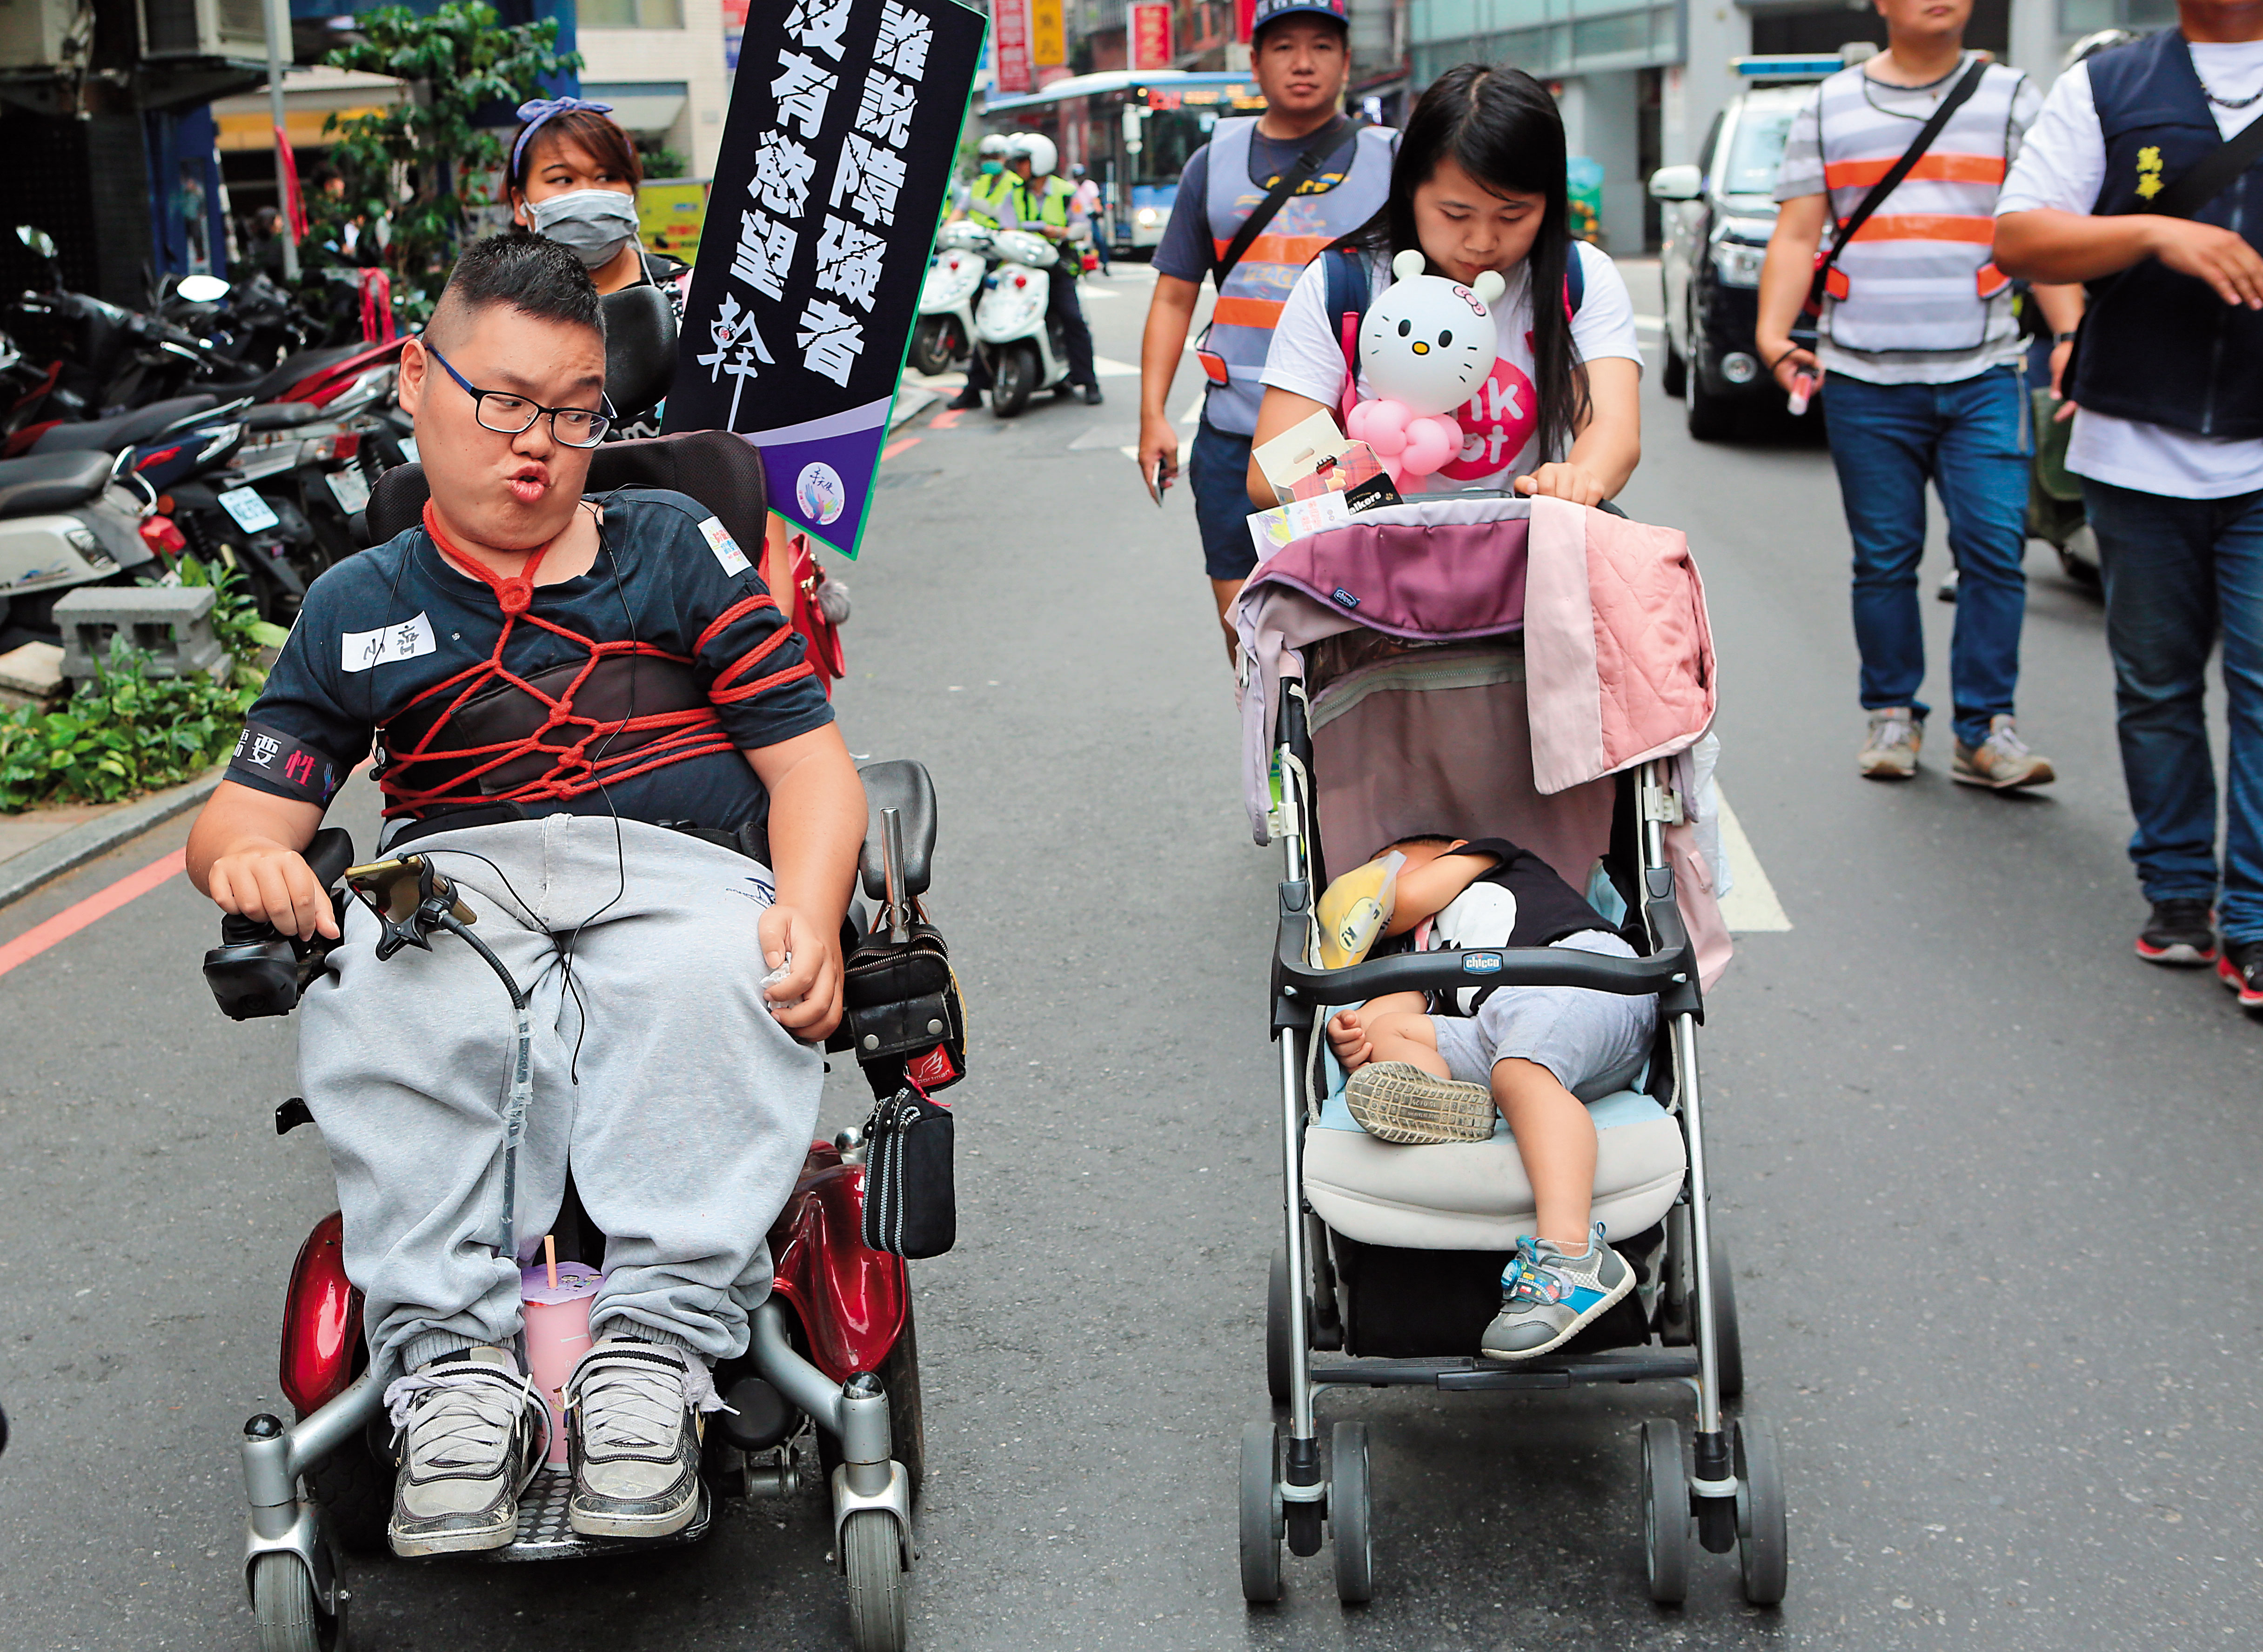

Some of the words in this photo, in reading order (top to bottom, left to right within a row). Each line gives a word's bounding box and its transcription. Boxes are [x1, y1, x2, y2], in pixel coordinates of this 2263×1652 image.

[796, 0, 933, 388] 誰說障礙者
[1466, 954, 1500, 968] chicco
